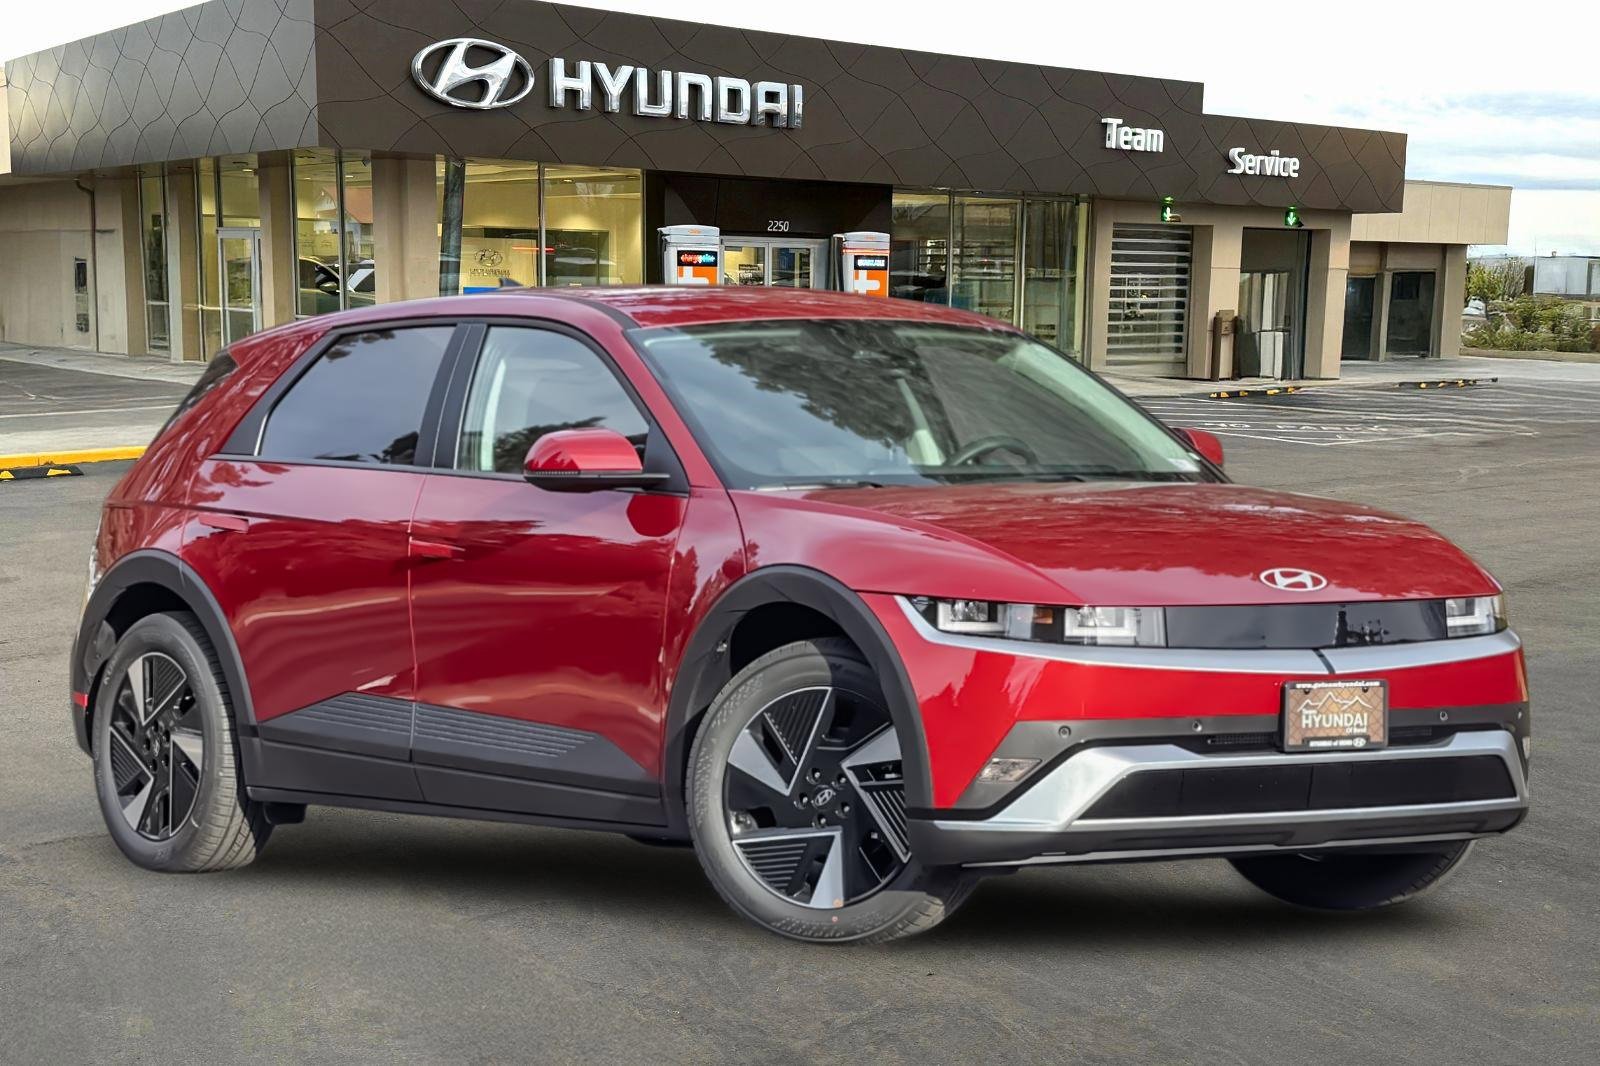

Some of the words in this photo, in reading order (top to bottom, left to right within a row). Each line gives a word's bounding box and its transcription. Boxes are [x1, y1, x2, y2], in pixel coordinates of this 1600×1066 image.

[548, 57, 803, 129] HYUNDAI
[1101, 117, 1164, 152] Team
[1227, 147, 1300, 177] Service
[767, 220, 790, 232] 2250
[1302, 712, 1368, 728] HYUNDAI
